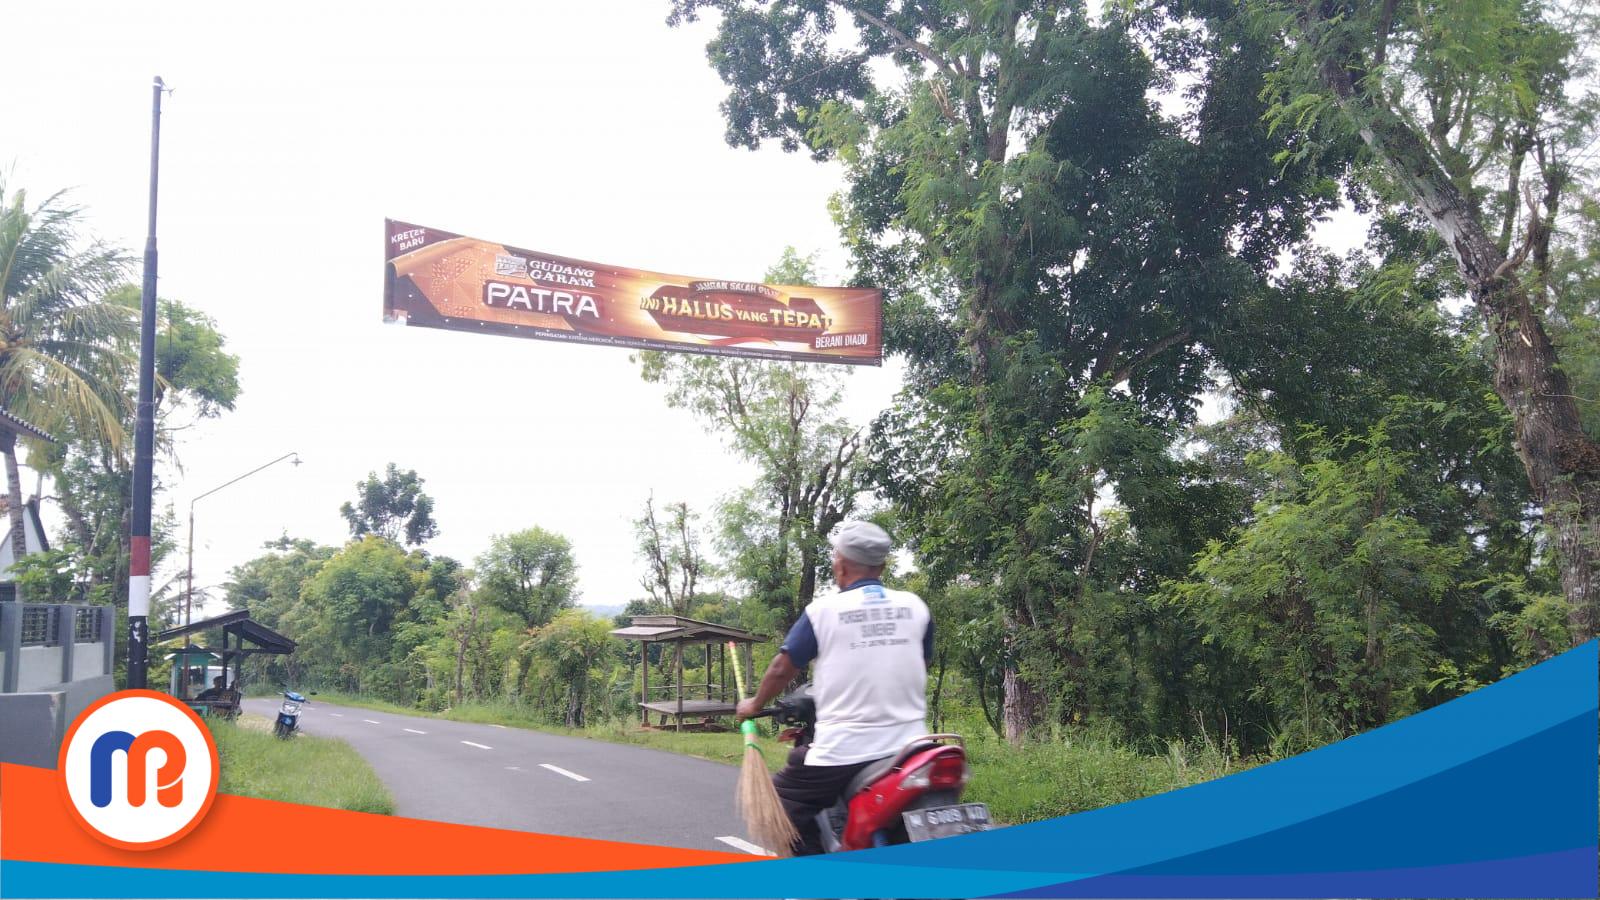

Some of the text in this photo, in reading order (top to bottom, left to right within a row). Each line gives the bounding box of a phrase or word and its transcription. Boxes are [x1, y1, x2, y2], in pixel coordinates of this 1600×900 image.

[391, 228, 426, 244] KRETEK
[399, 236, 425, 251] BARU
[529, 260, 595, 278] GUDANG
[530, 269, 596, 288] GARAM
[696, 281, 728, 292] JANGAN
[730, 282, 756, 292] SALAH
[487, 282, 600, 318] PATRA
[641, 295, 832, 329] INI HALUS YANG TEPAT
[815, 333, 868, 348] BERANI DIADU
